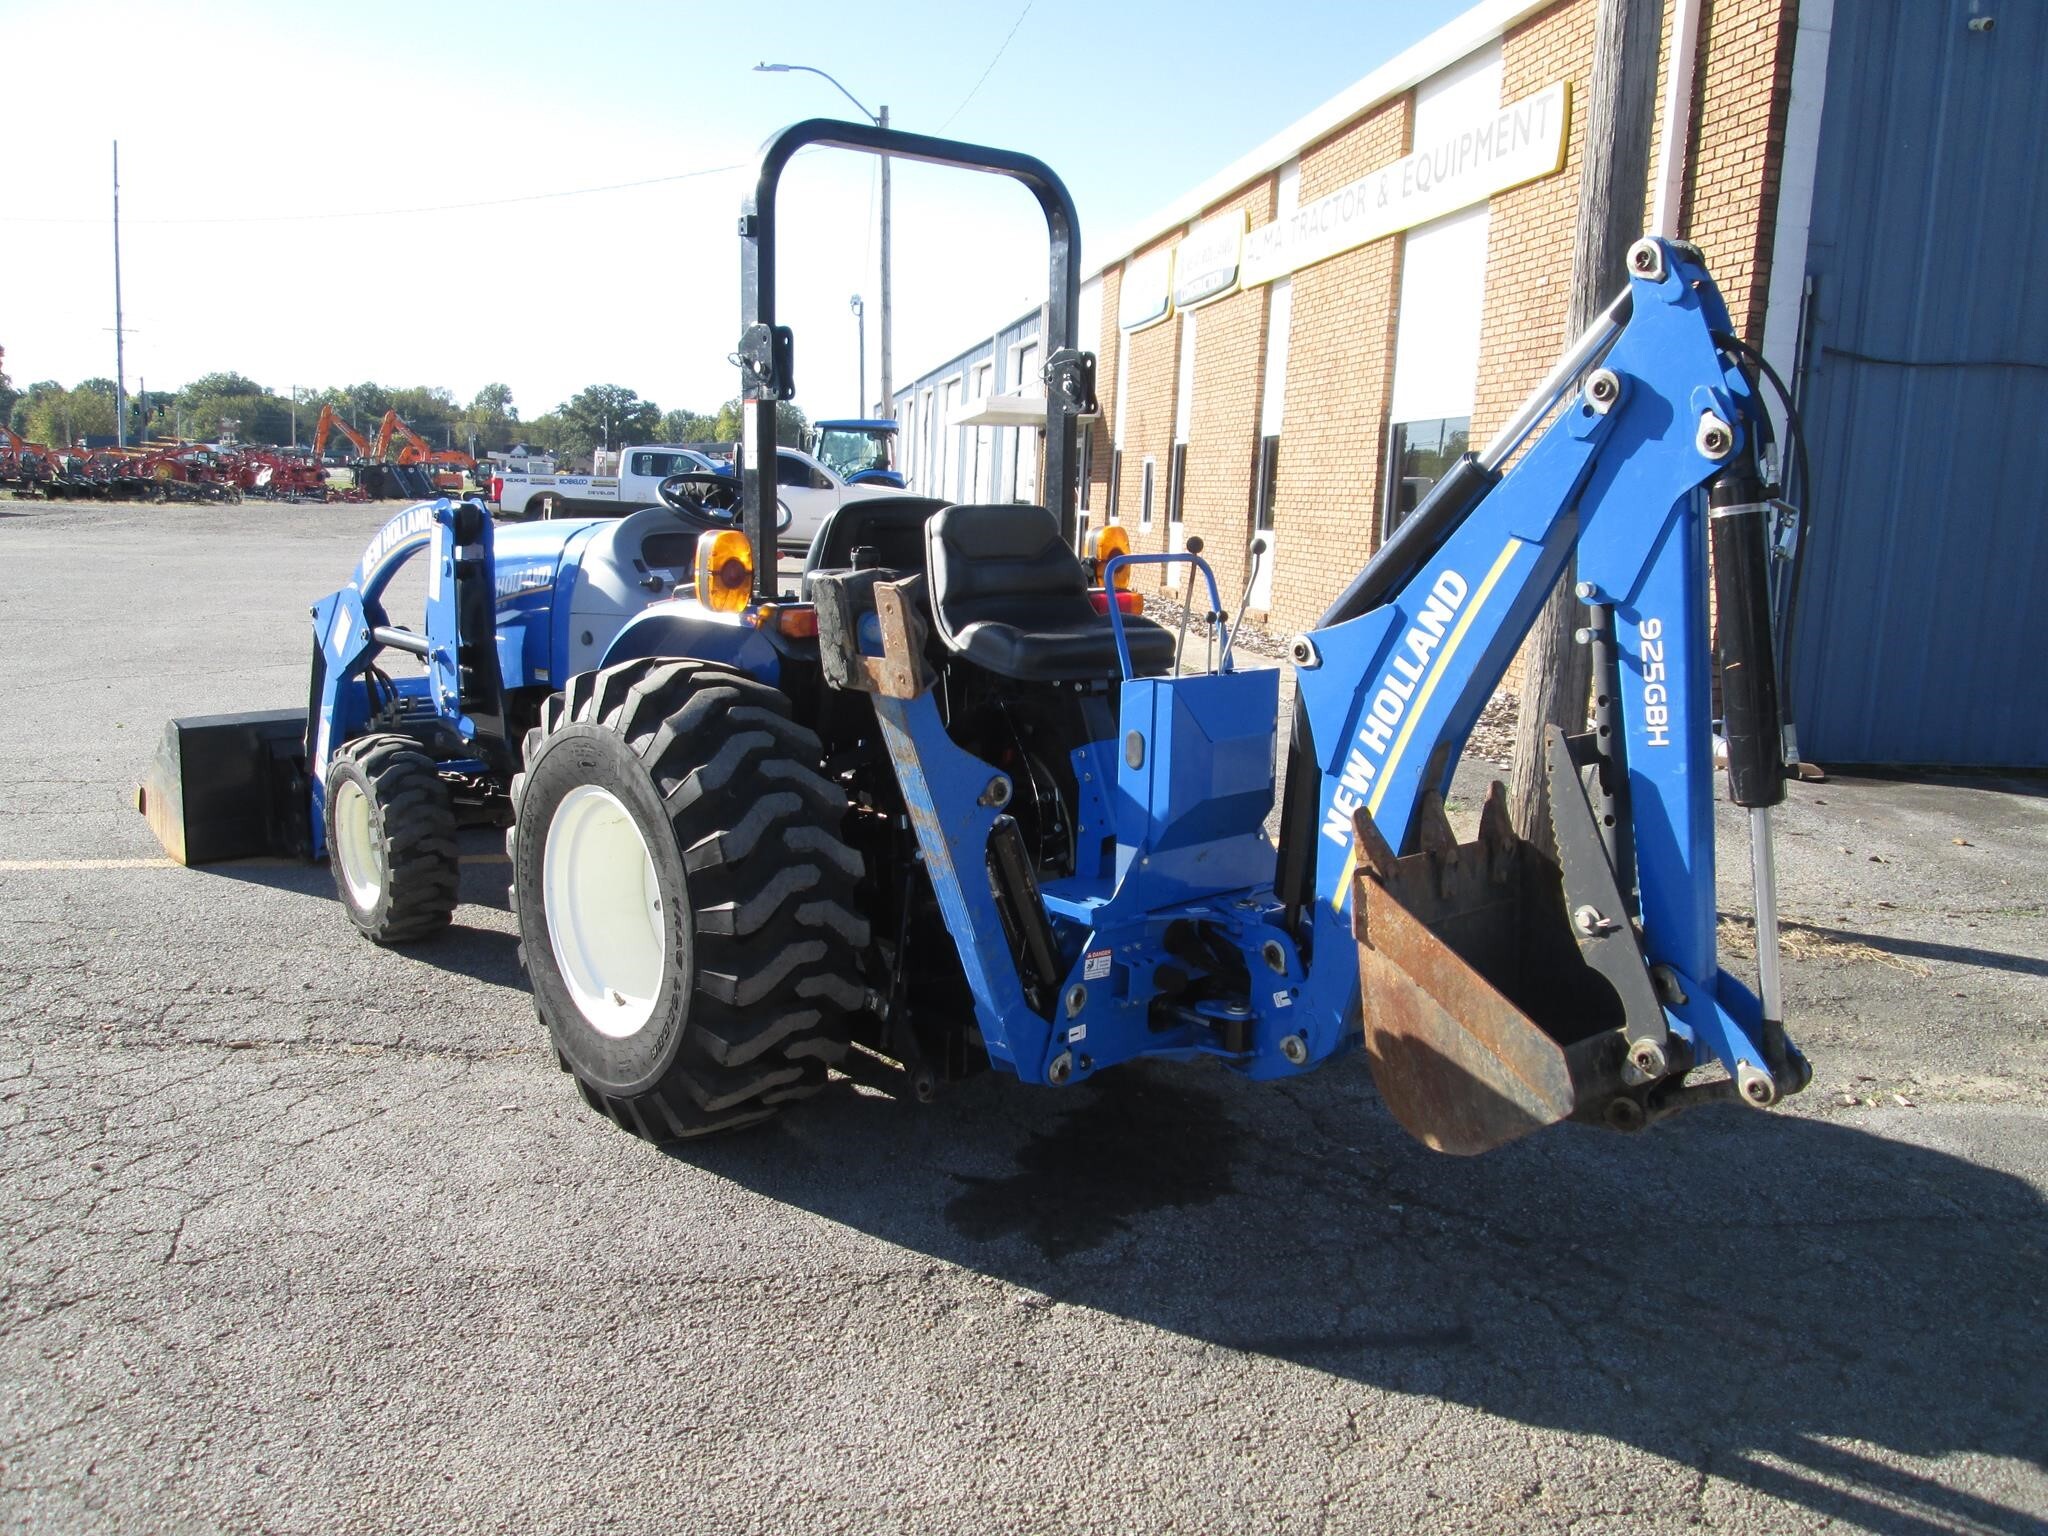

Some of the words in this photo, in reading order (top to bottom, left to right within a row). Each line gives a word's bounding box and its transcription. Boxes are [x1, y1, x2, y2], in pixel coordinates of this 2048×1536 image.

[1290, 182, 1366, 244] TRACTOR
[1377, 173, 1388, 208] &
[1402, 93, 1554, 199] EQUIPMENT
[362, 532, 382, 580] NEW
[383, 507, 432, 553] HOLLAND
[1322, 749, 1377, 847] NEW
[1359, 570, 1468, 754] HOLLAND
[1639, 618, 1669, 747] 925GBH
